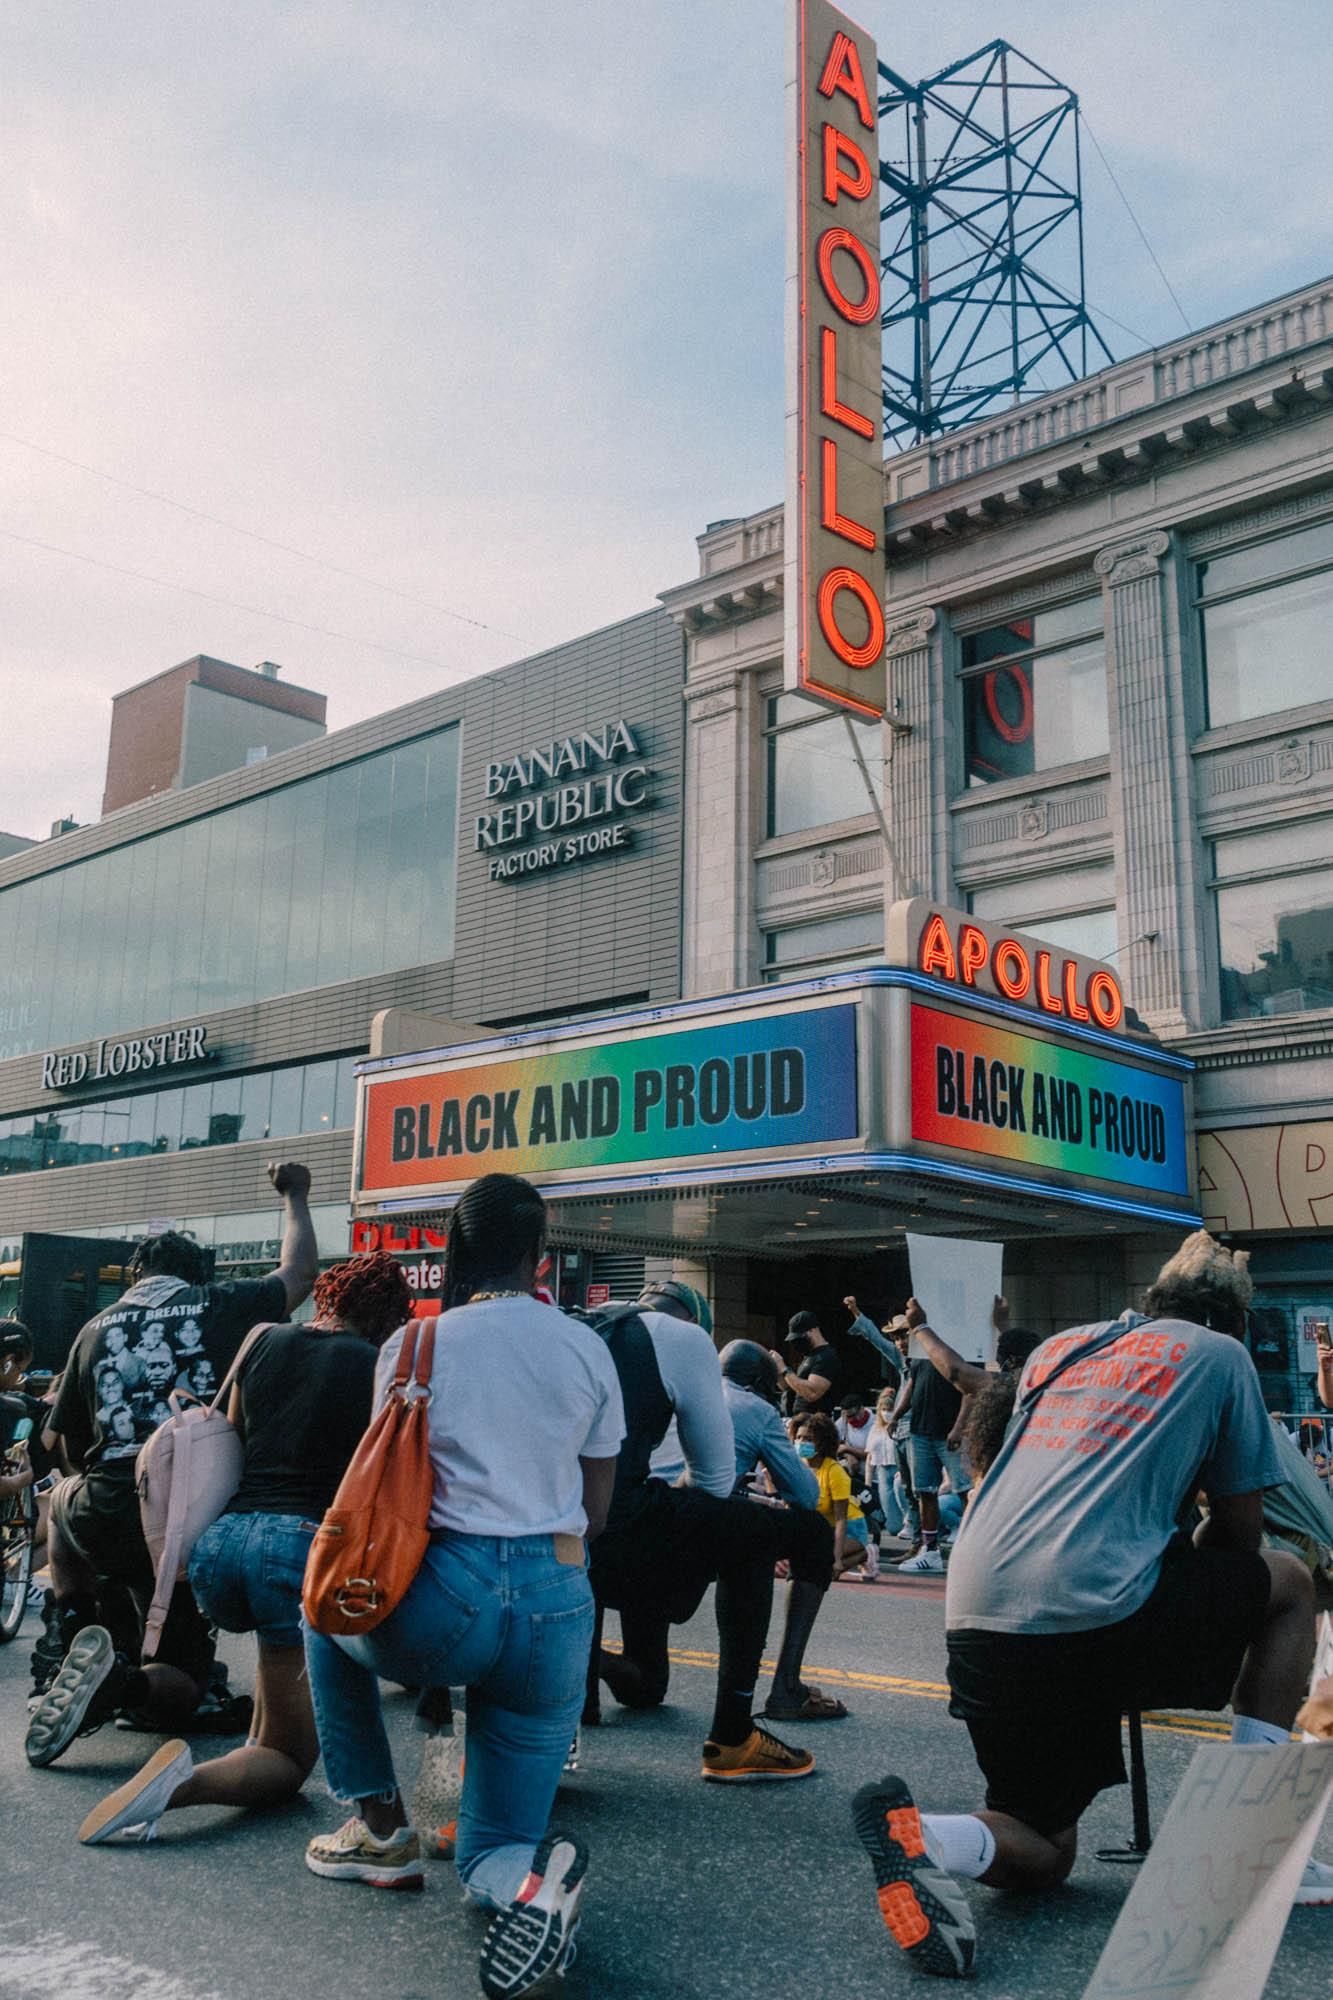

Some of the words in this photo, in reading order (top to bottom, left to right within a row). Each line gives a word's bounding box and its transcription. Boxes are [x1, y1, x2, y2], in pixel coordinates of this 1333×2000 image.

[816, 30, 887, 669] APOLLO
[484, 719, 638, 799] BANANA
[474, 766, 648, 851] REPUBLIC
[488, 842, 560, 881] FACTORY
[564, 823, 626, 862] STORE
[920, 912, 1123, 1030] APOLLO
[41, 1052, 88, 1090] RED
[94, 1026, 207, 1079] LOBSTER
[392, 1089, 520, 1162] BLACK
[528, 1075, 620, 1146] AND
[633, 1048, 805, 1133] PROUD
[936, 1045, 1026, 1132] BLACK
[1032, 1072, 1083, 1145] AND
[1089, 1087, 1166, 1164] PROUD
[101, 1311, 140, 1327] CAN'T
